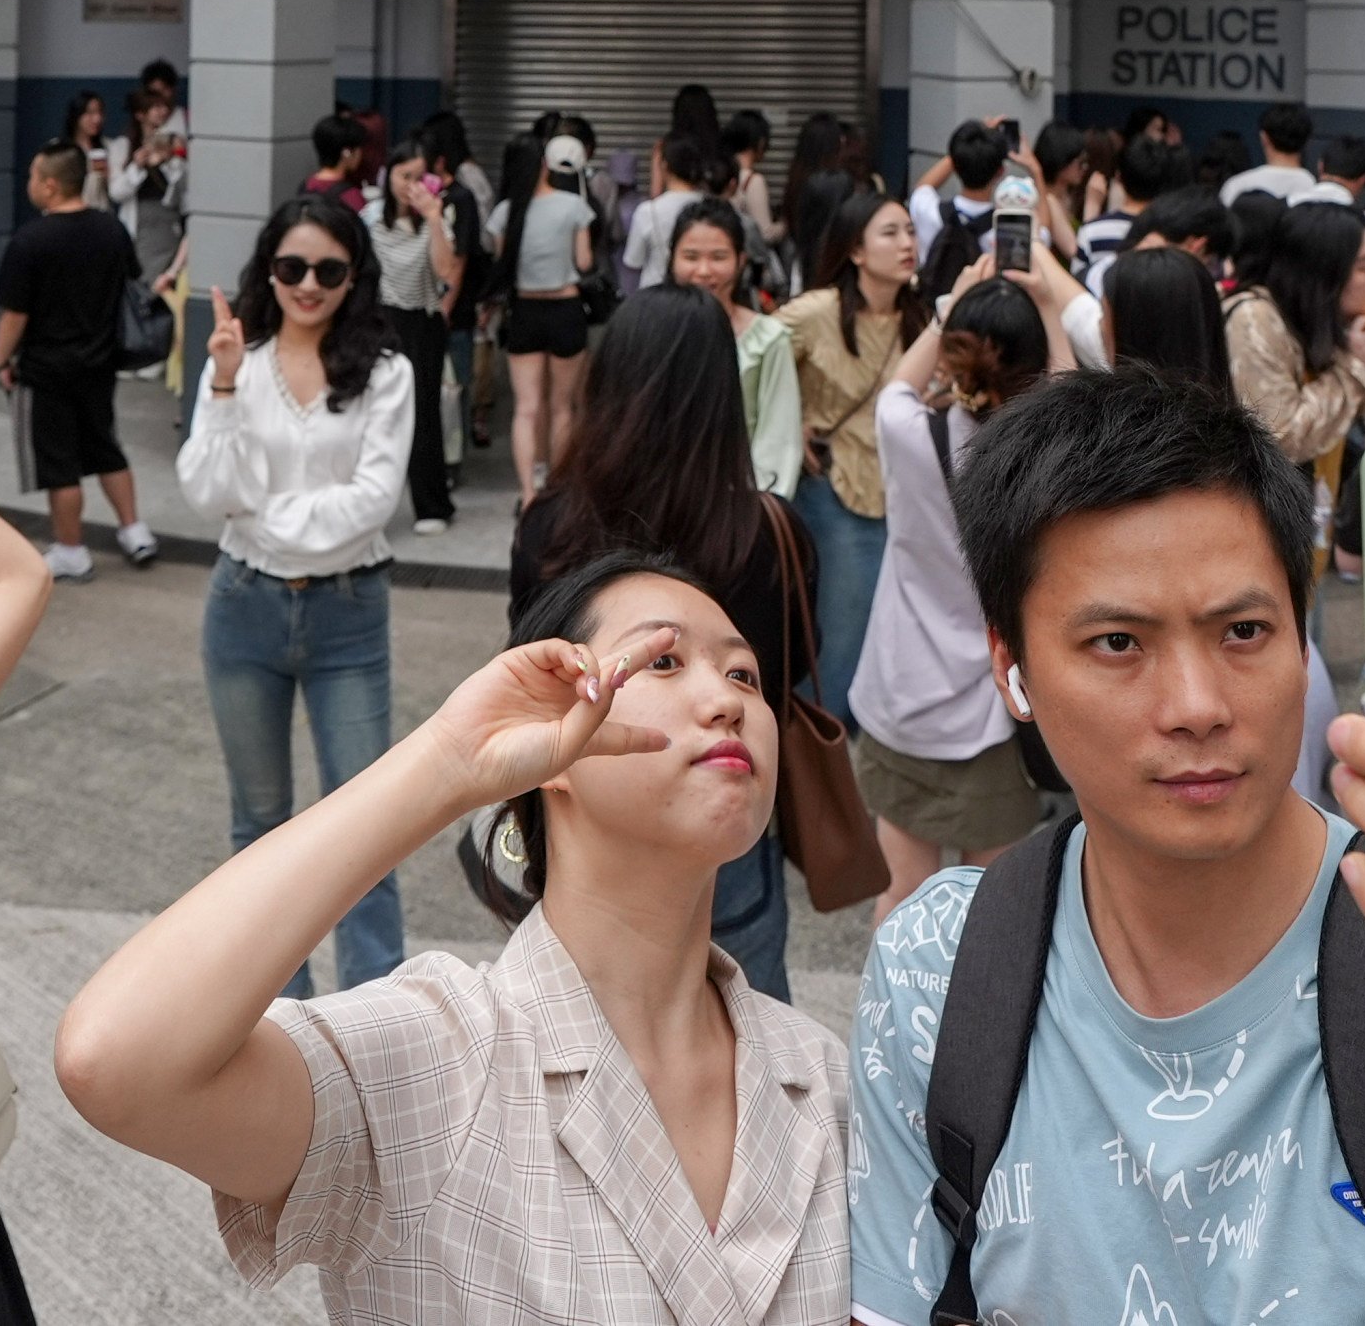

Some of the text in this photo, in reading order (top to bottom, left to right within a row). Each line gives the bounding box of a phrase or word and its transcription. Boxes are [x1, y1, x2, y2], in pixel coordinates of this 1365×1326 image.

[1117, 6, 1278, 45] POLICE
[1112, 49, 1284, 92] STATION
[885, 967, 951, 994] NATURE
